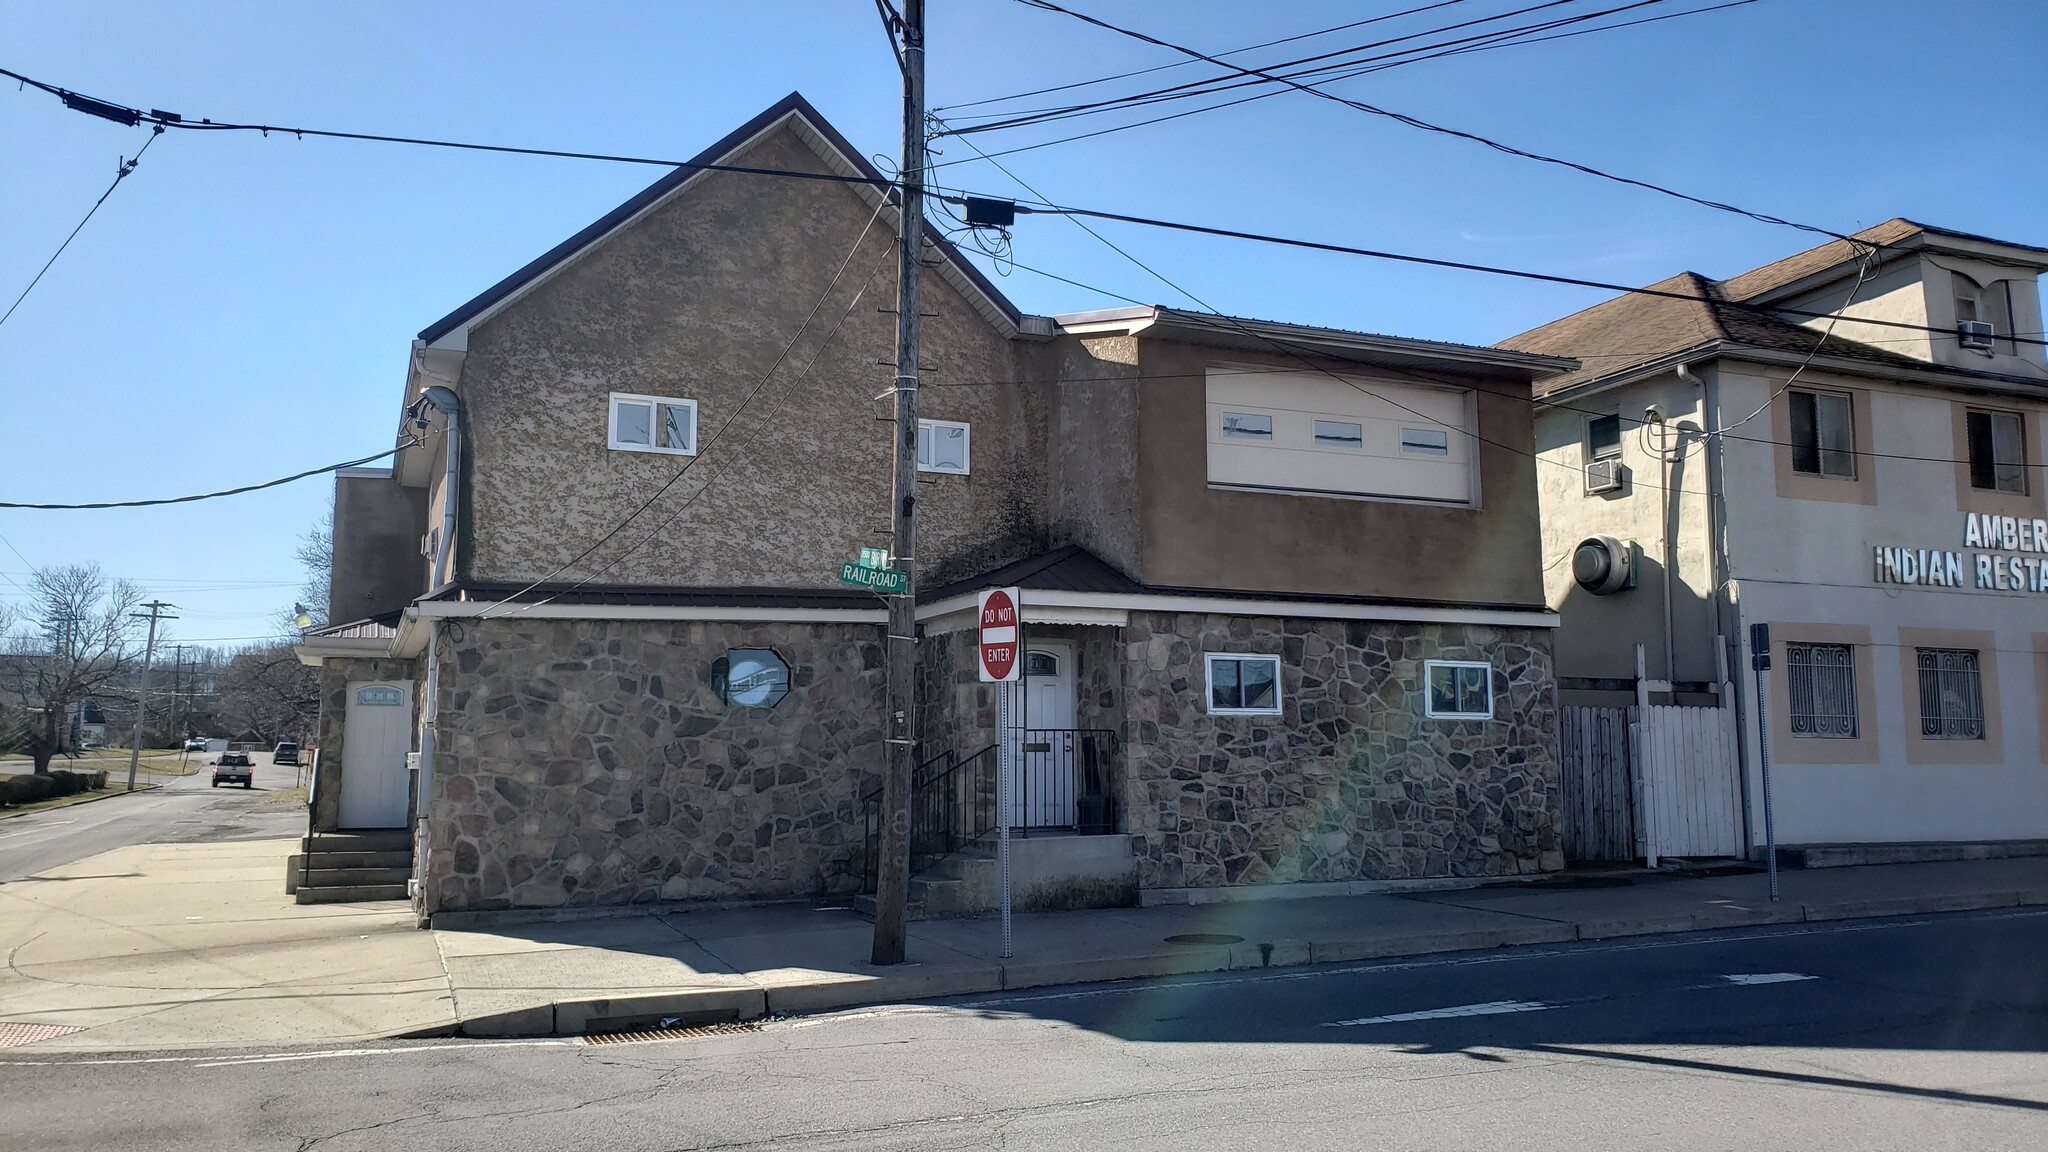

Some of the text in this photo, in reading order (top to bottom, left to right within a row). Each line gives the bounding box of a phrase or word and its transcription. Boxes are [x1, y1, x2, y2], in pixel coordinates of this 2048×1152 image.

[1965, 512, 2048, 553] AMBER
[843, 564, 898, 588] RAILROAD
[1875, 546, 1964, 587] INDIAN
[985, 607, 1012, 623] DO NOT
[988, 648, 1010, 662] ENTER
